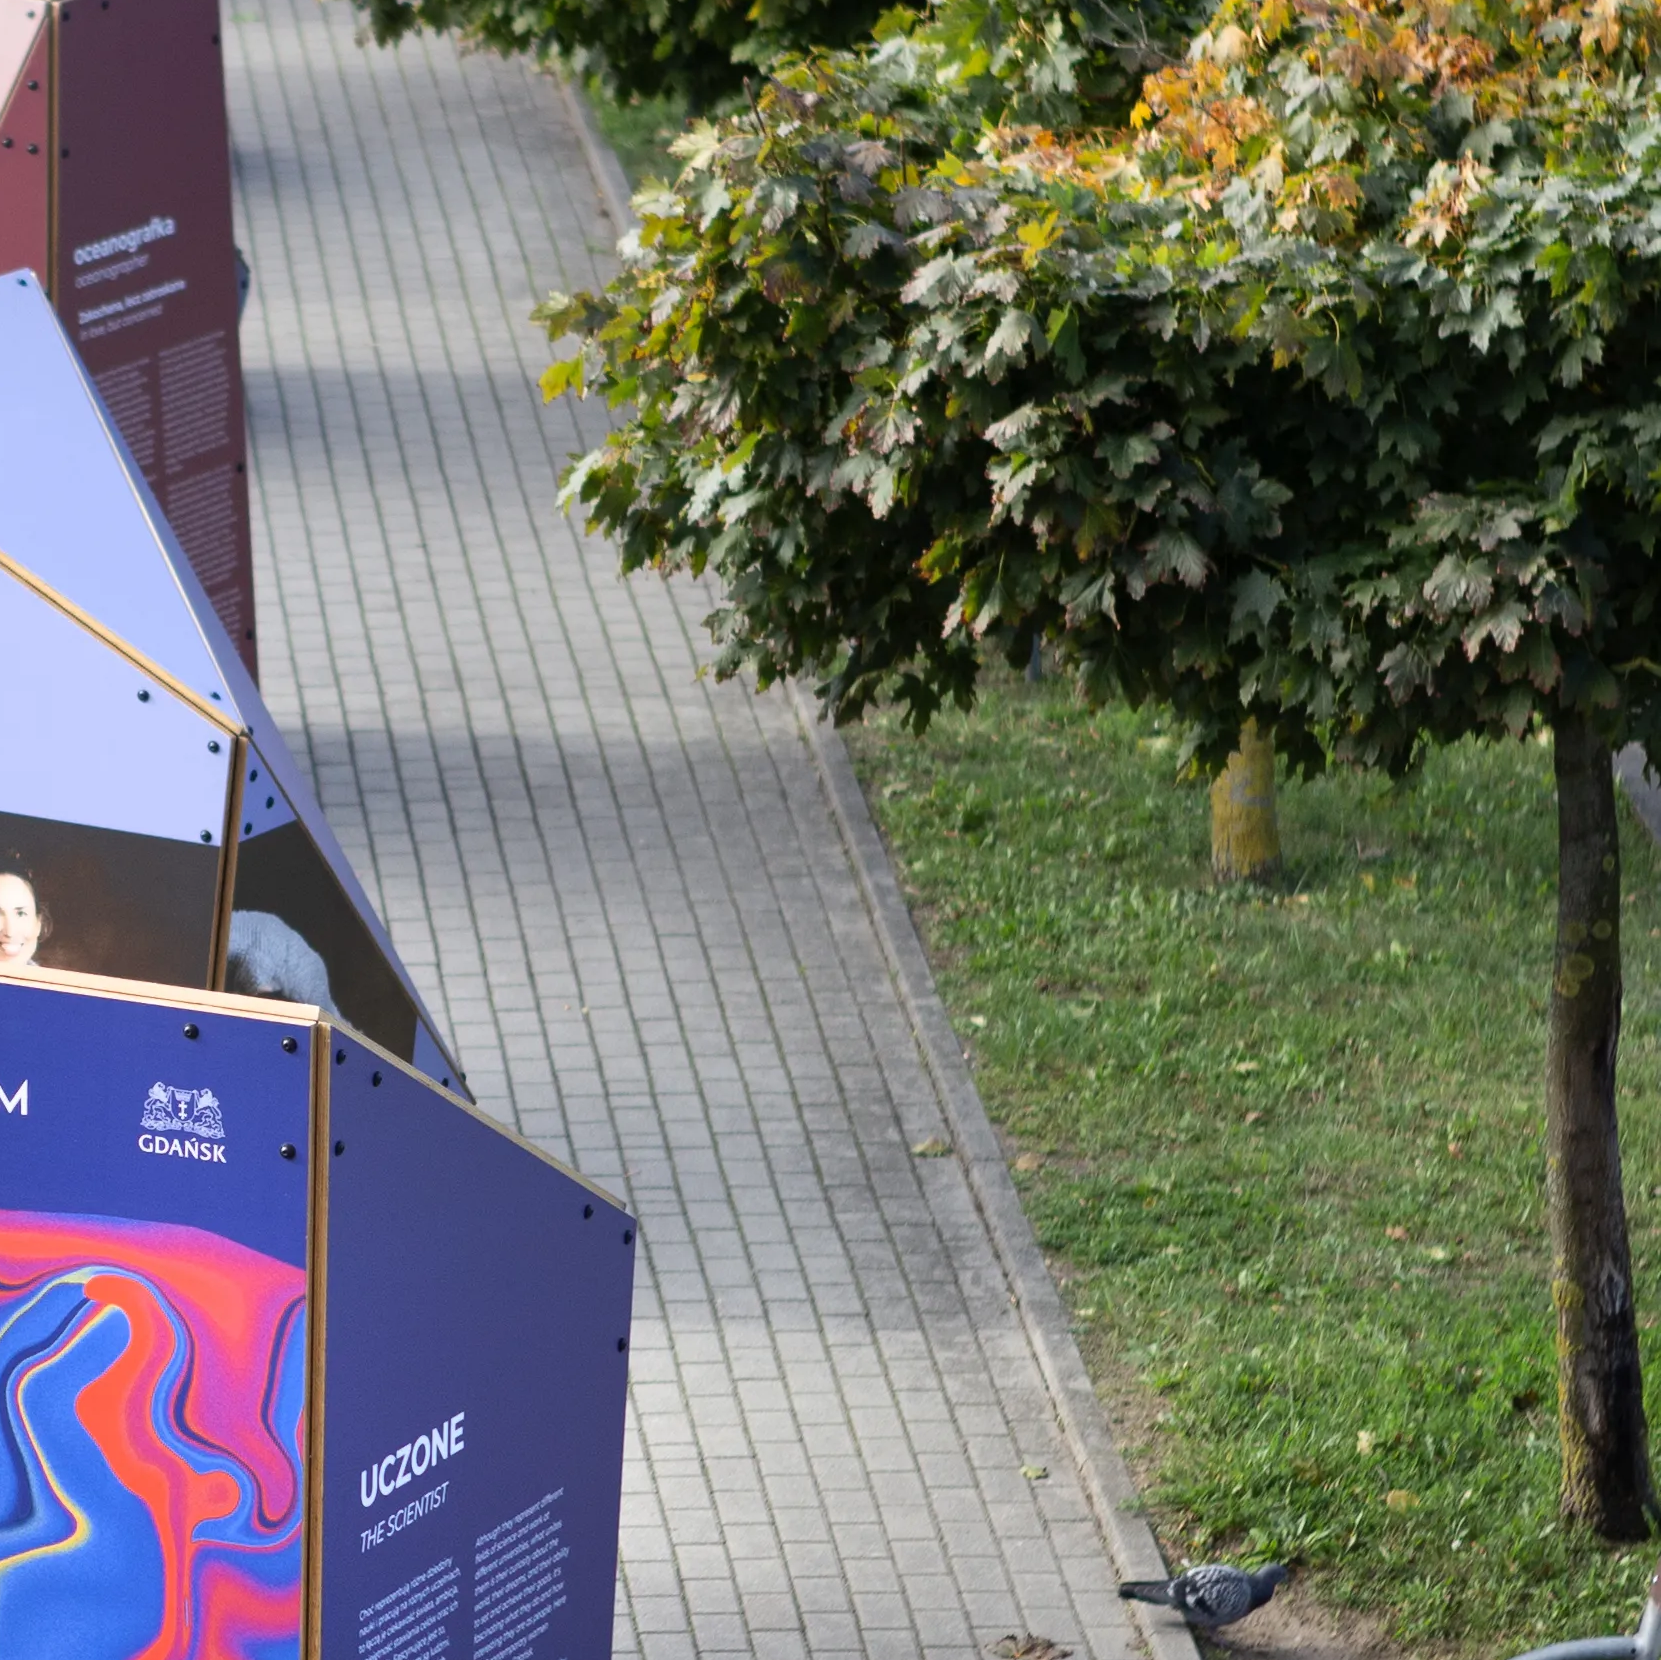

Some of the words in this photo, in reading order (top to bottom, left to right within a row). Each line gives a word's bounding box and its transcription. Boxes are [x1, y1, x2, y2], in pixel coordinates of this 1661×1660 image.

[73, 216, 176, 265] oceanografka
[137, 1131, 227, 1164] GDAŃSK
[360, 1411, 465, 1508] UCZONE
[360, 1521, 386, 1552] THE
[387, 1481, 450, 1536] SCIENTIST
